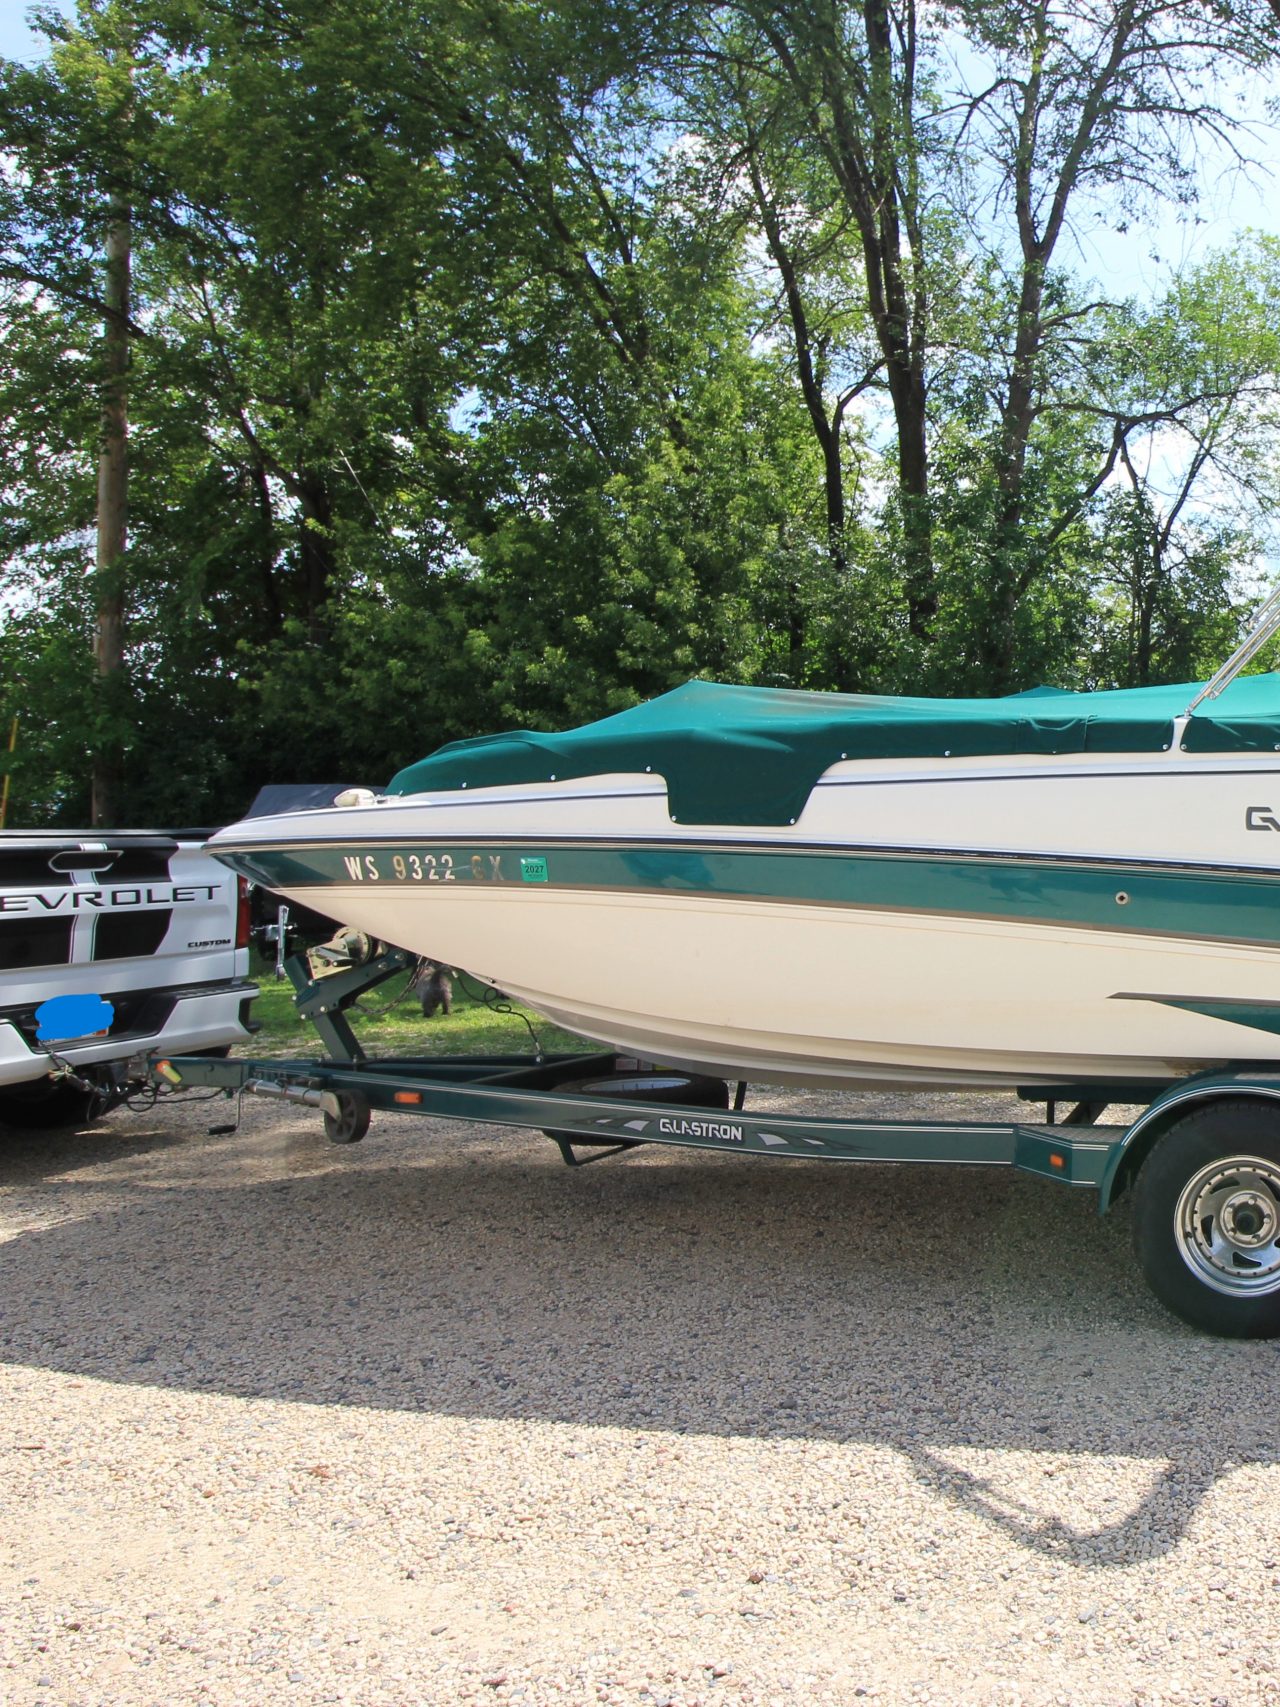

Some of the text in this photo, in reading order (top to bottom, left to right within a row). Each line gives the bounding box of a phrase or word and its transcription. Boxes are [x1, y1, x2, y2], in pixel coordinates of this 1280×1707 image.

[343, 855, 379, 881] WS
[392, 854, 456, 881] 9322
[524, 865, 545, 874] 2027
[0, 885, 222, 912] EVROLET
[187, 939, 231, 948] CUSTOM
[659, 1117, 743, 1141] GLASTRON
